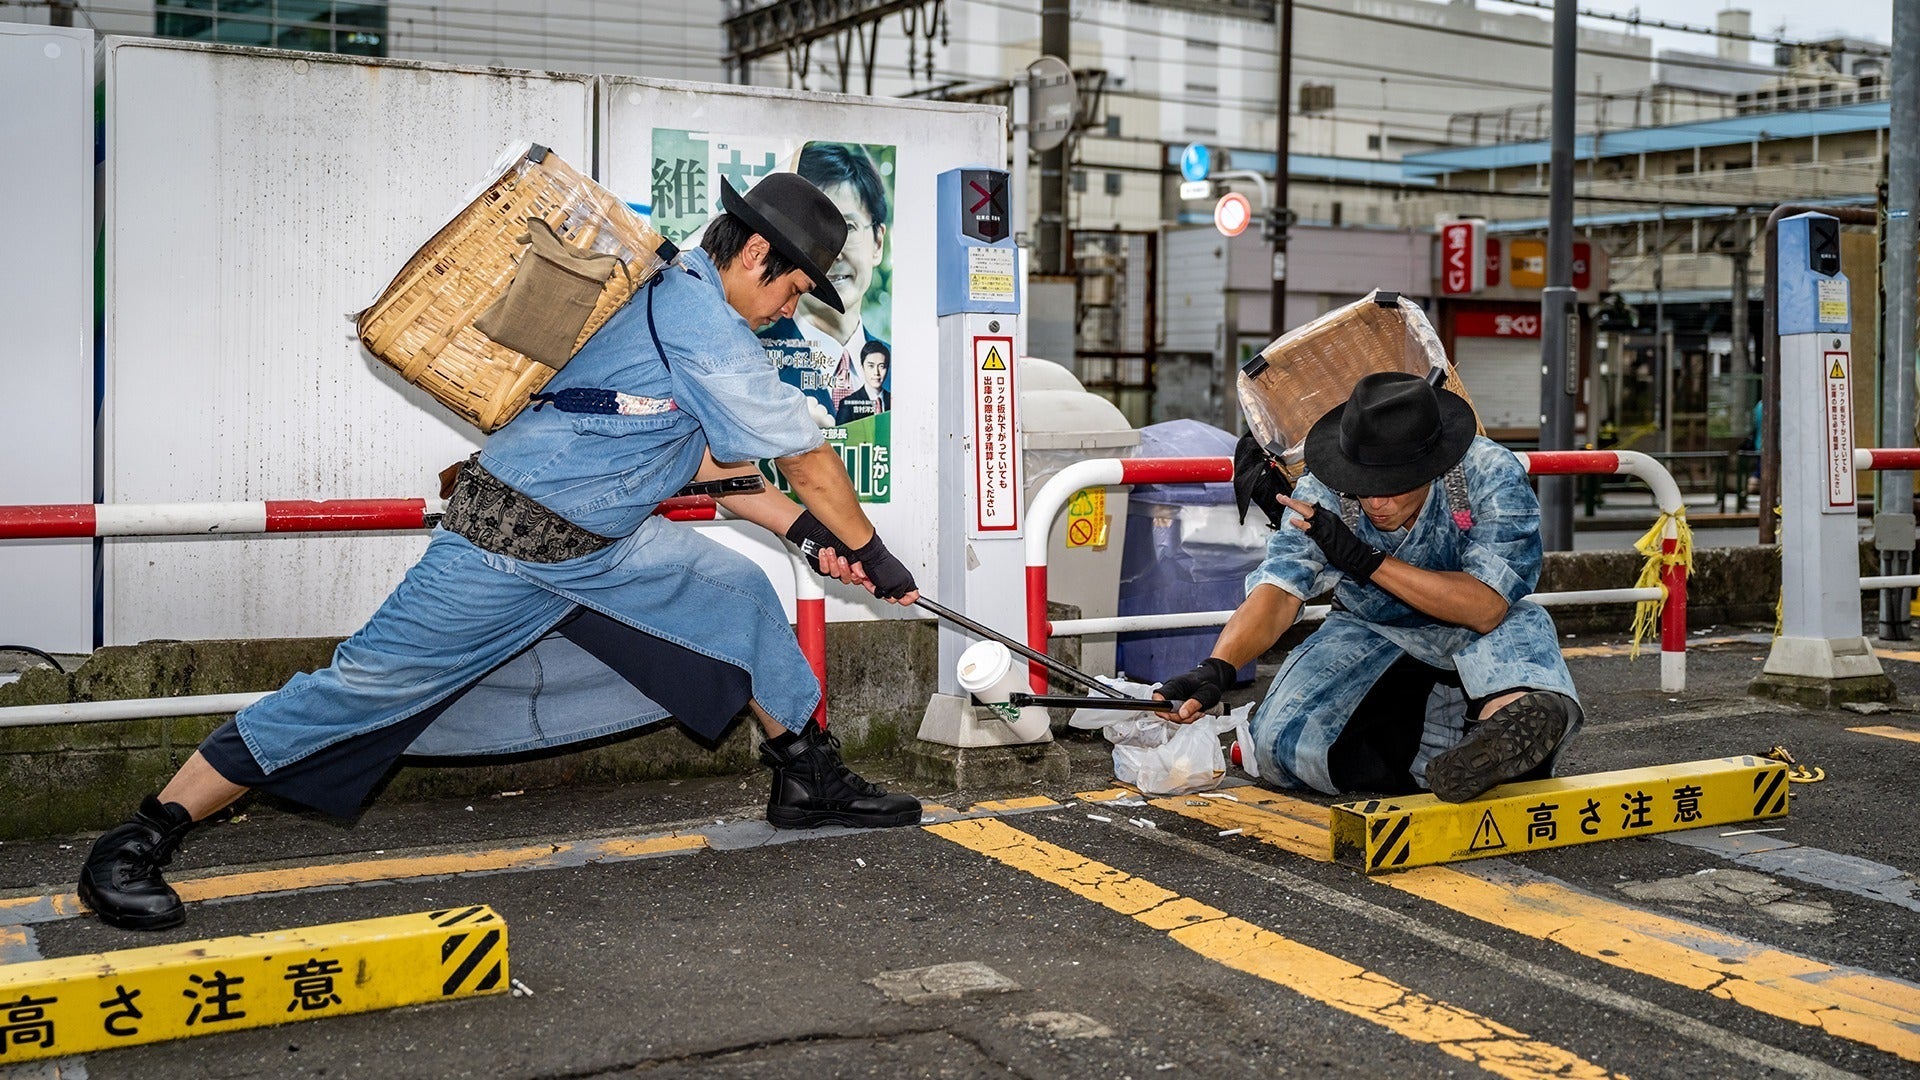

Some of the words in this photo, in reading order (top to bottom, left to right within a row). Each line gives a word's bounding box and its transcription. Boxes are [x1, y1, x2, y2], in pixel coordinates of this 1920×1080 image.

[872, 444, 890, 497] たかし
[996, 376, 1008, 489] ロック板が下がっていても
[1526, 784, 1704, 845] 高さ注意
[0, 958, 343, 1056] 高さ注意
